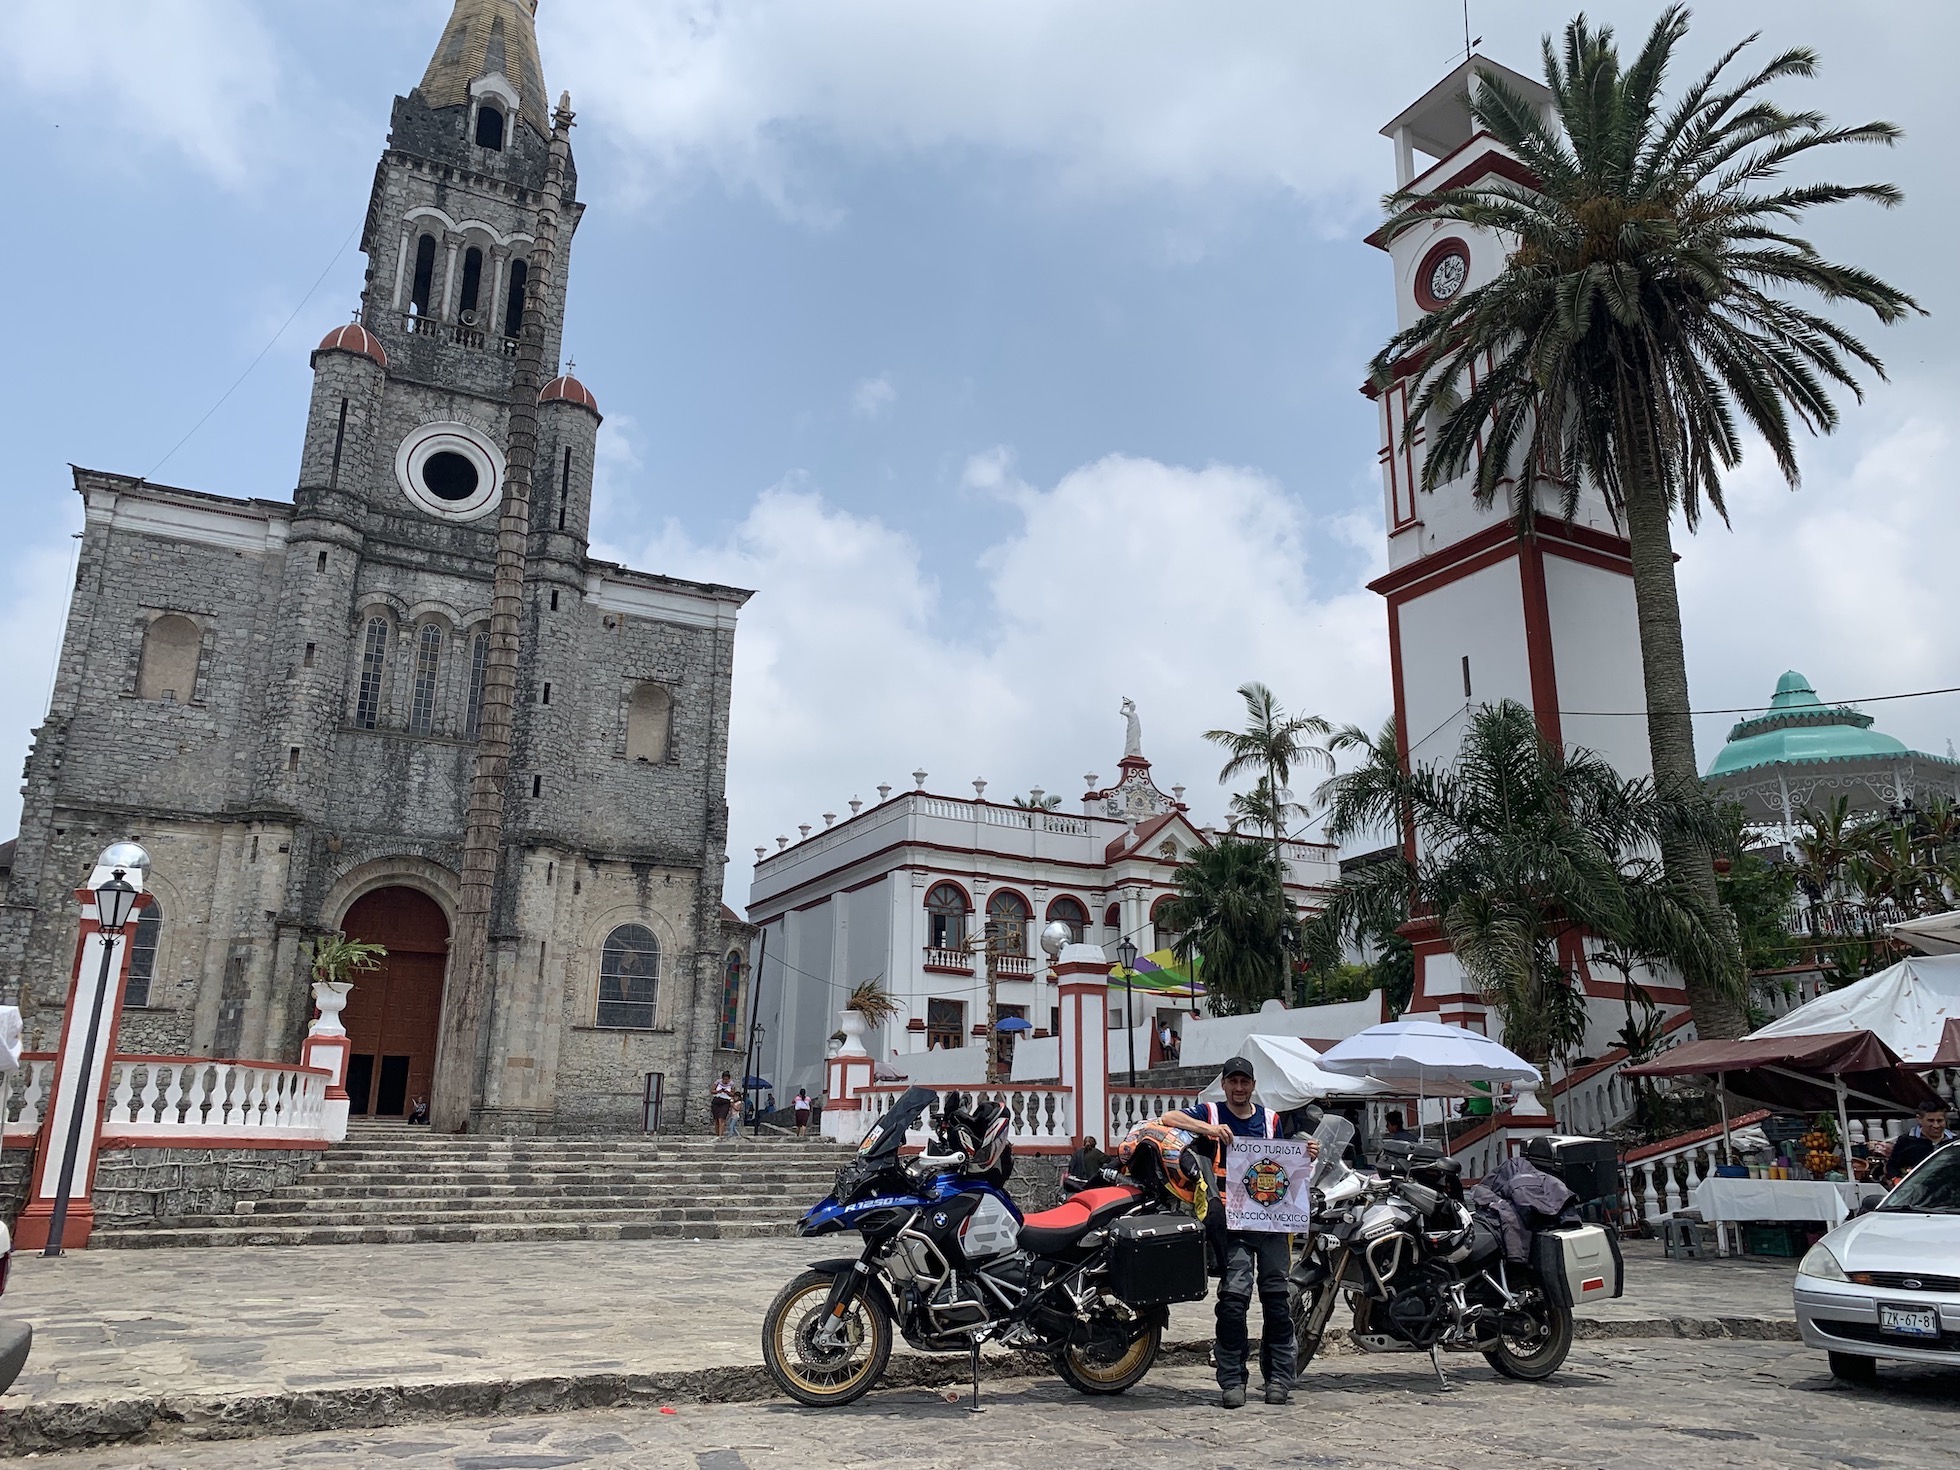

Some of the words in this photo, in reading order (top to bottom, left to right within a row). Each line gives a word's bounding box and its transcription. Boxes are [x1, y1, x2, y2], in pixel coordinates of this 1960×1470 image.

[1231, 1143, 1262, 1154] MOTO
[1263, 1144, 1302, 1155] TURISTA
[1228, 1211, 1239, 1220] EN
[1240, 1210, 1272, 1221] ACCIÓN
[1273, 1211, 1308, 1223] MÉXICO
[1881, 1311, 1936, 1328] TZK-67-81
